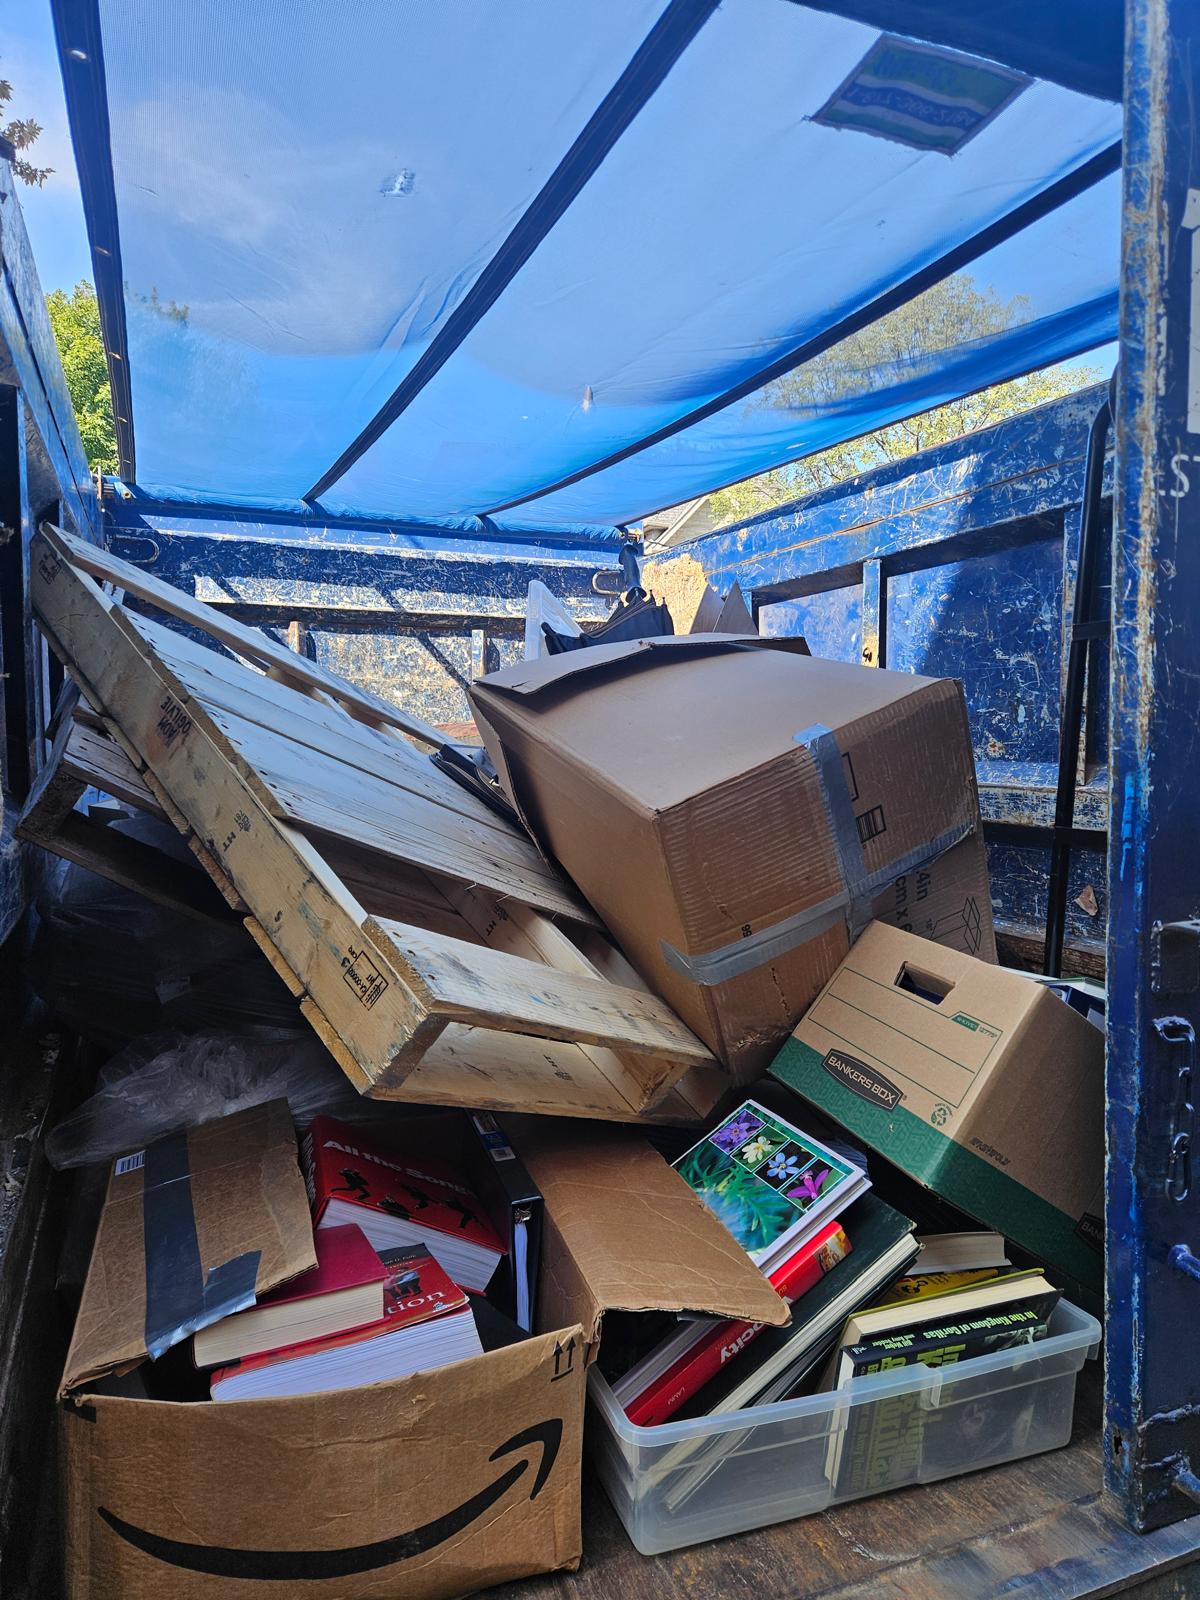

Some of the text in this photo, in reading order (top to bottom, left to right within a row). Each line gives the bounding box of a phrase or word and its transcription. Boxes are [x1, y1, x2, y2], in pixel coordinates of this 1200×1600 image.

[159, 695, 192, 735] OGILVIE
[895, 876, 908, 905] cm
[827, 1055, 897, 1105] BANKERS BOX
[322, 1140, 360, 1156] All
[361, 1152, 403, 1171] the
[922, 1310, 1038, 1339] In the Kingdom of Gorillas
